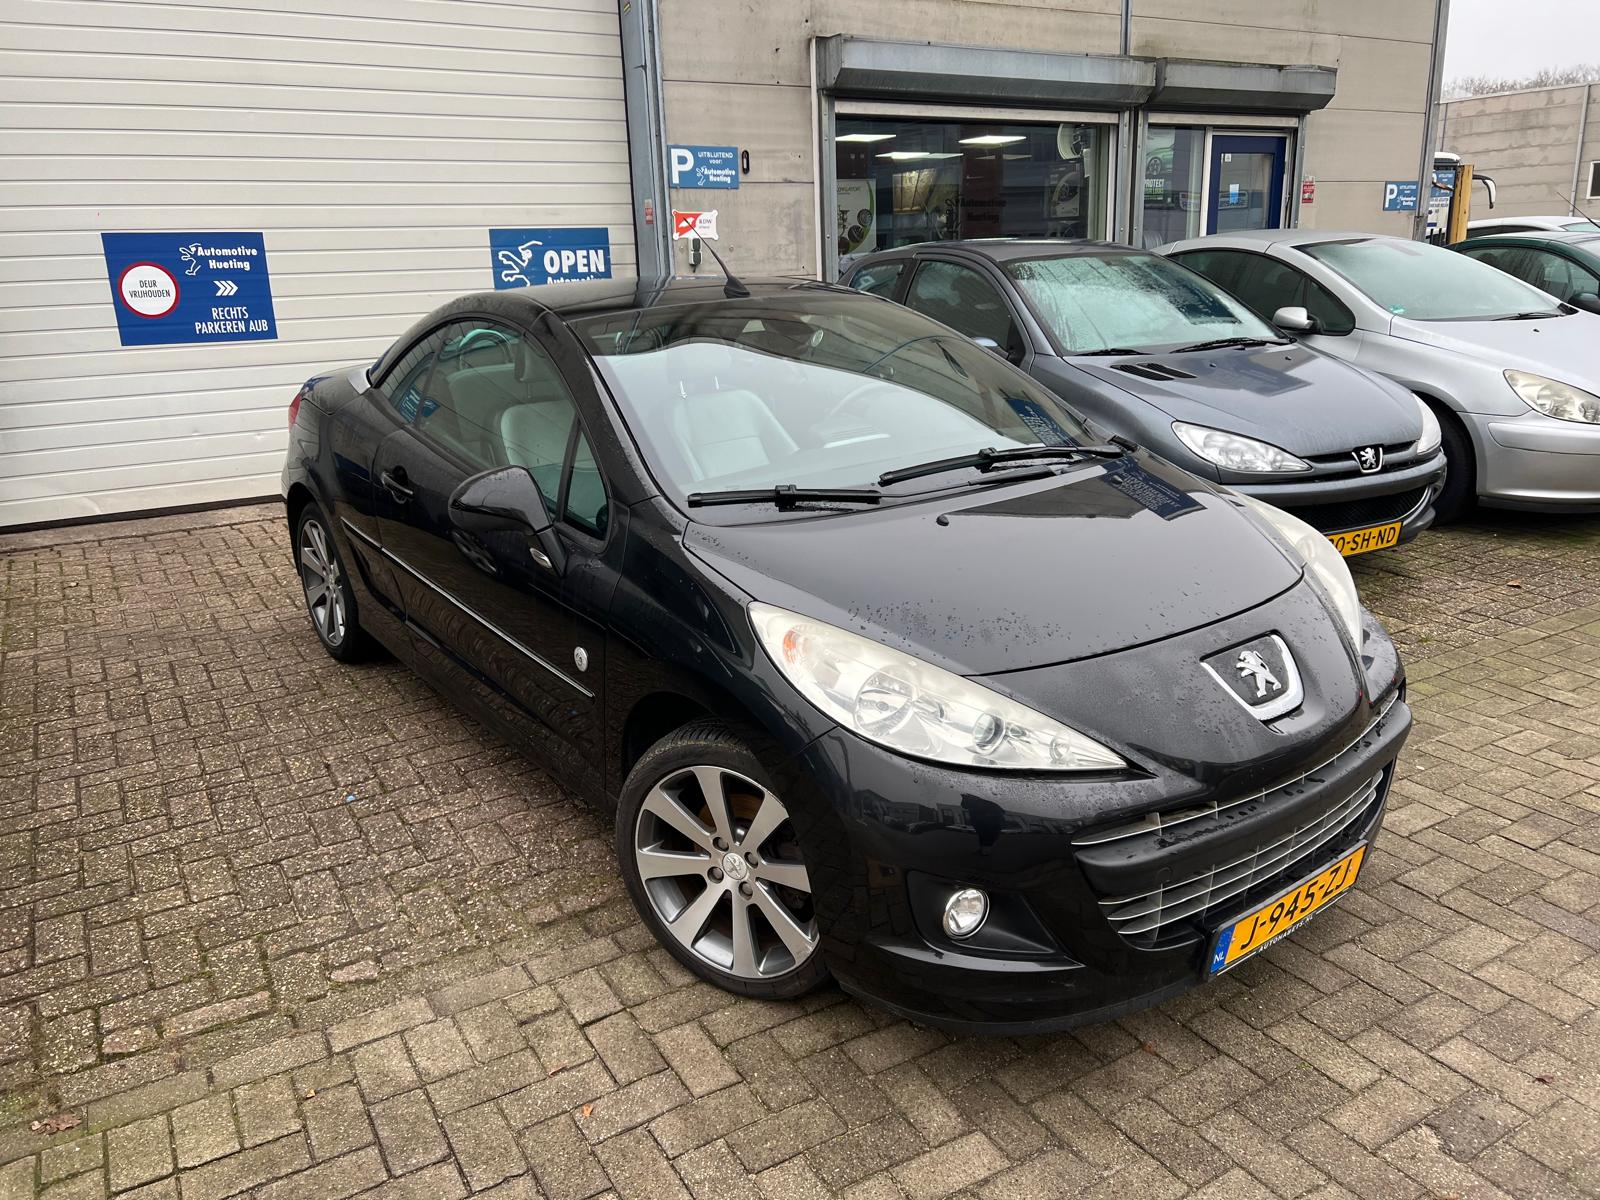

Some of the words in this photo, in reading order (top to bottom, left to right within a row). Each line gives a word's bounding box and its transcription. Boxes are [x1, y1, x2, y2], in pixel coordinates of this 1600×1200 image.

[670, 148, 695, 184] P
[703, 168, 736, 176] Automotive
[1385, 184, 1398, 208] P
[197, 245, 258, 257] Automotive
[208, 259, 251, 272] Hueting
[543, 249, 606, 274] OPEN
[139, 279, 158, 289] DEUR
[129, 289, 171, 299] VRIJHOUDEN
[211, 306, 249, 320] RECHTS
[194, 320, 246, 334] PARKEREN
[249, 319, 269, 333] AUB
[1240, 858, 1354, 951] J-945-ZJ
[1213, 951, 1225, 965] NL
